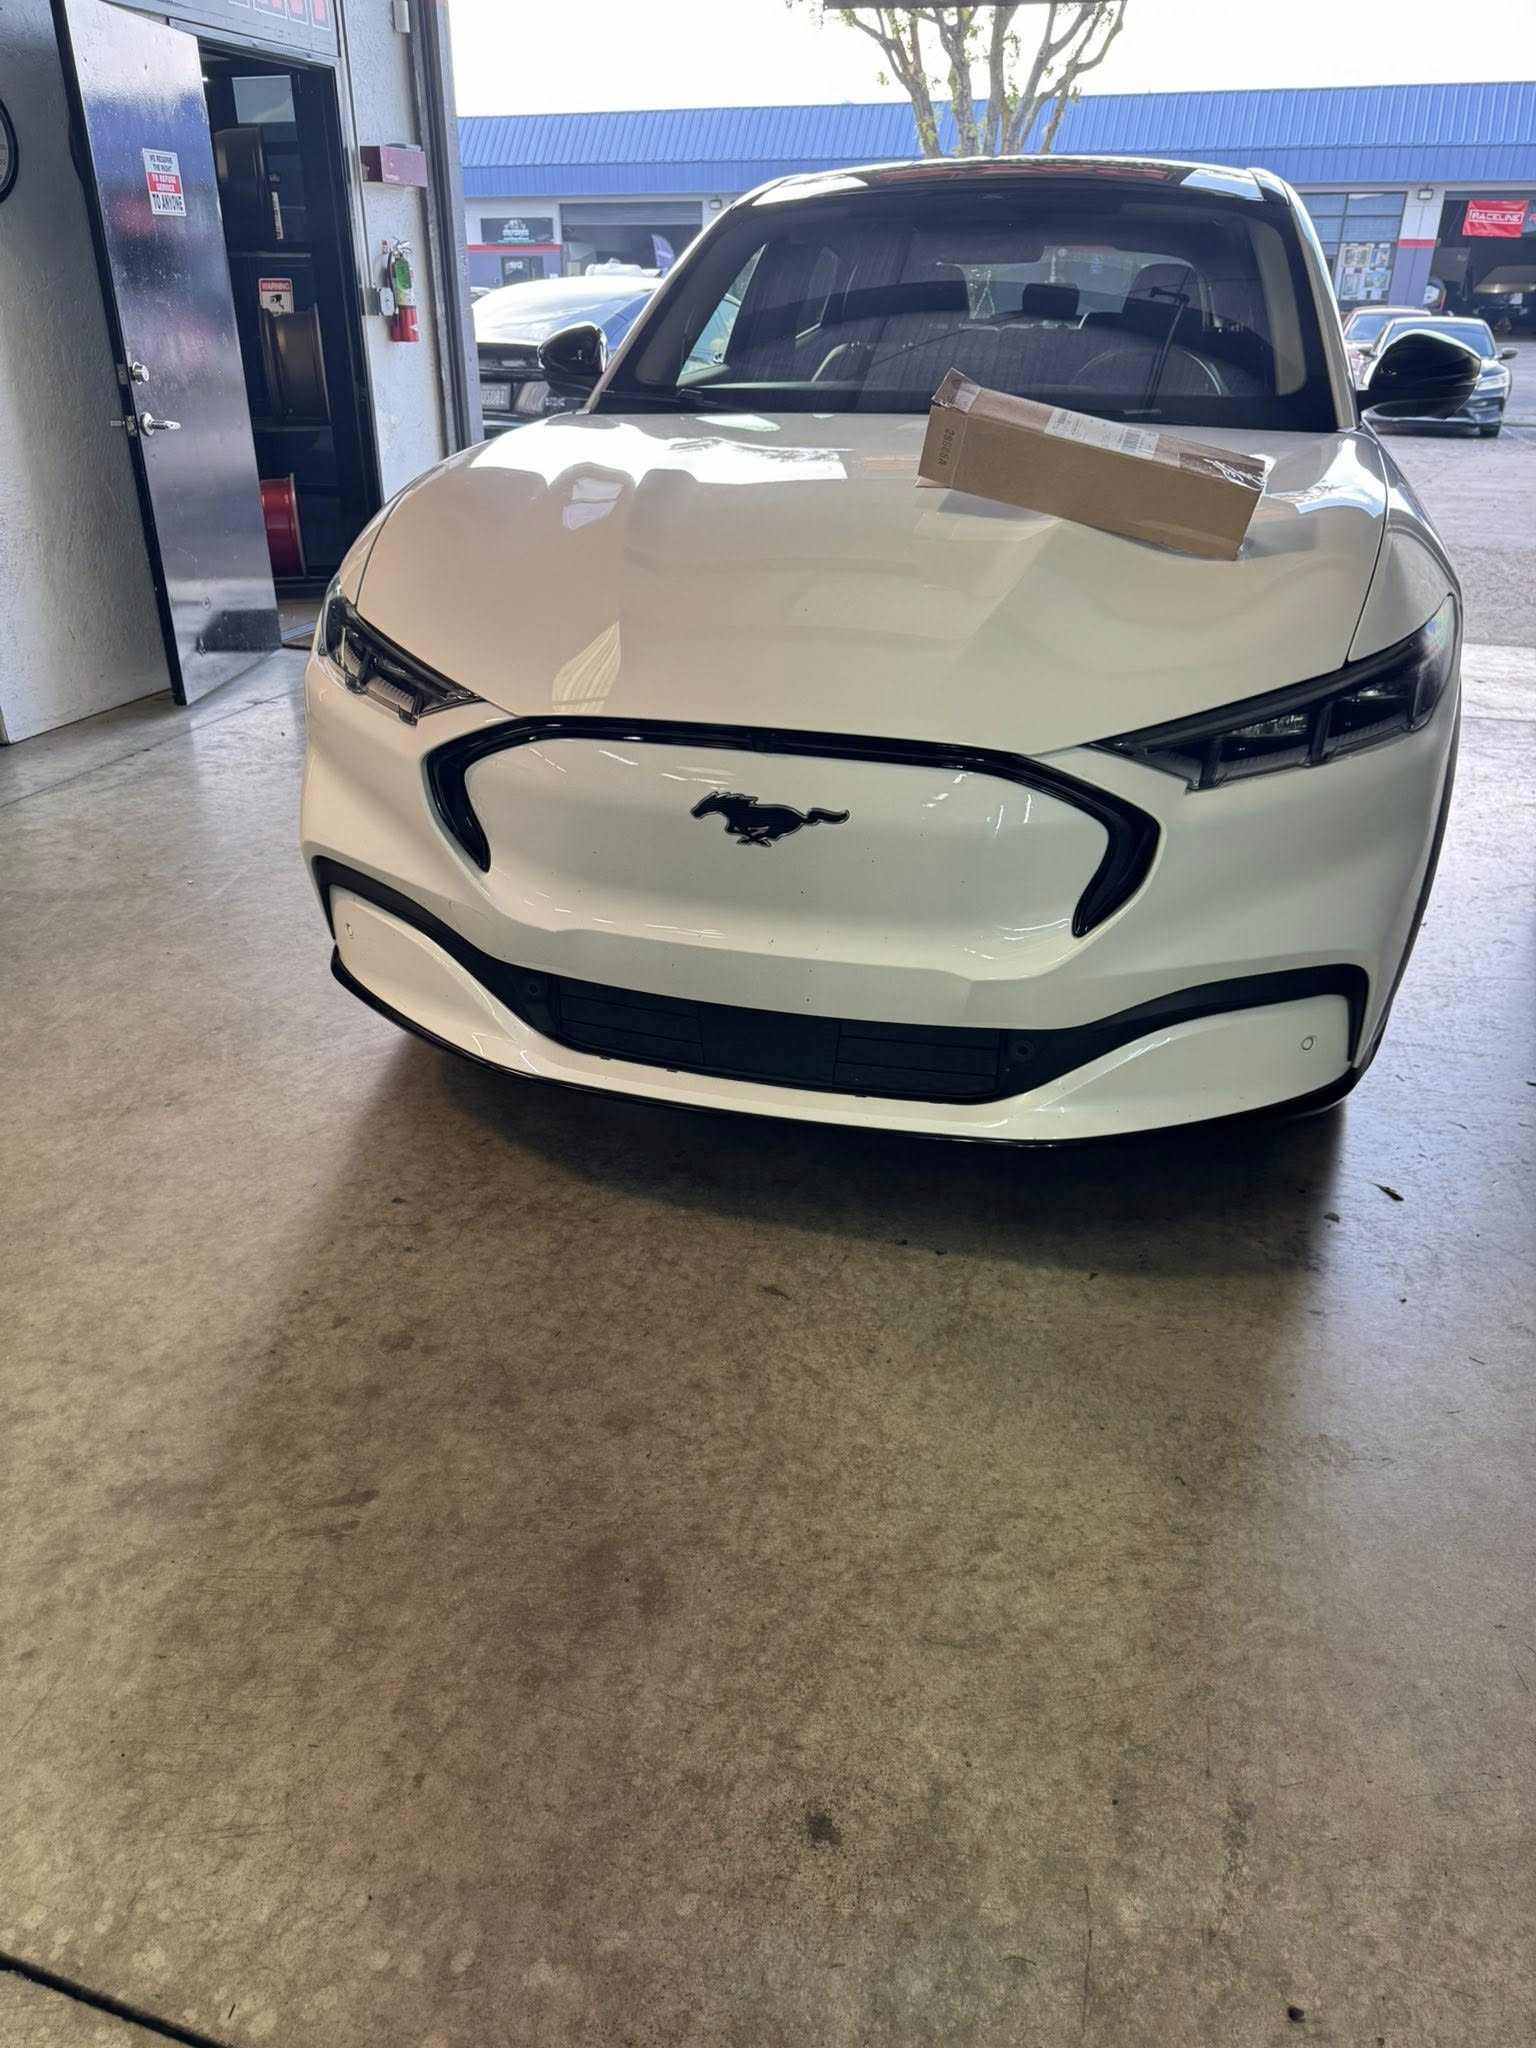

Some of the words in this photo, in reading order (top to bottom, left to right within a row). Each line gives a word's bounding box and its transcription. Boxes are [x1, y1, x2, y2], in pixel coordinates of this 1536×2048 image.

[152, 193, 161, 209] TO
[161, 194, 184, 210] ANYONE
[1471, 212, 1521, 222] RACELINE
